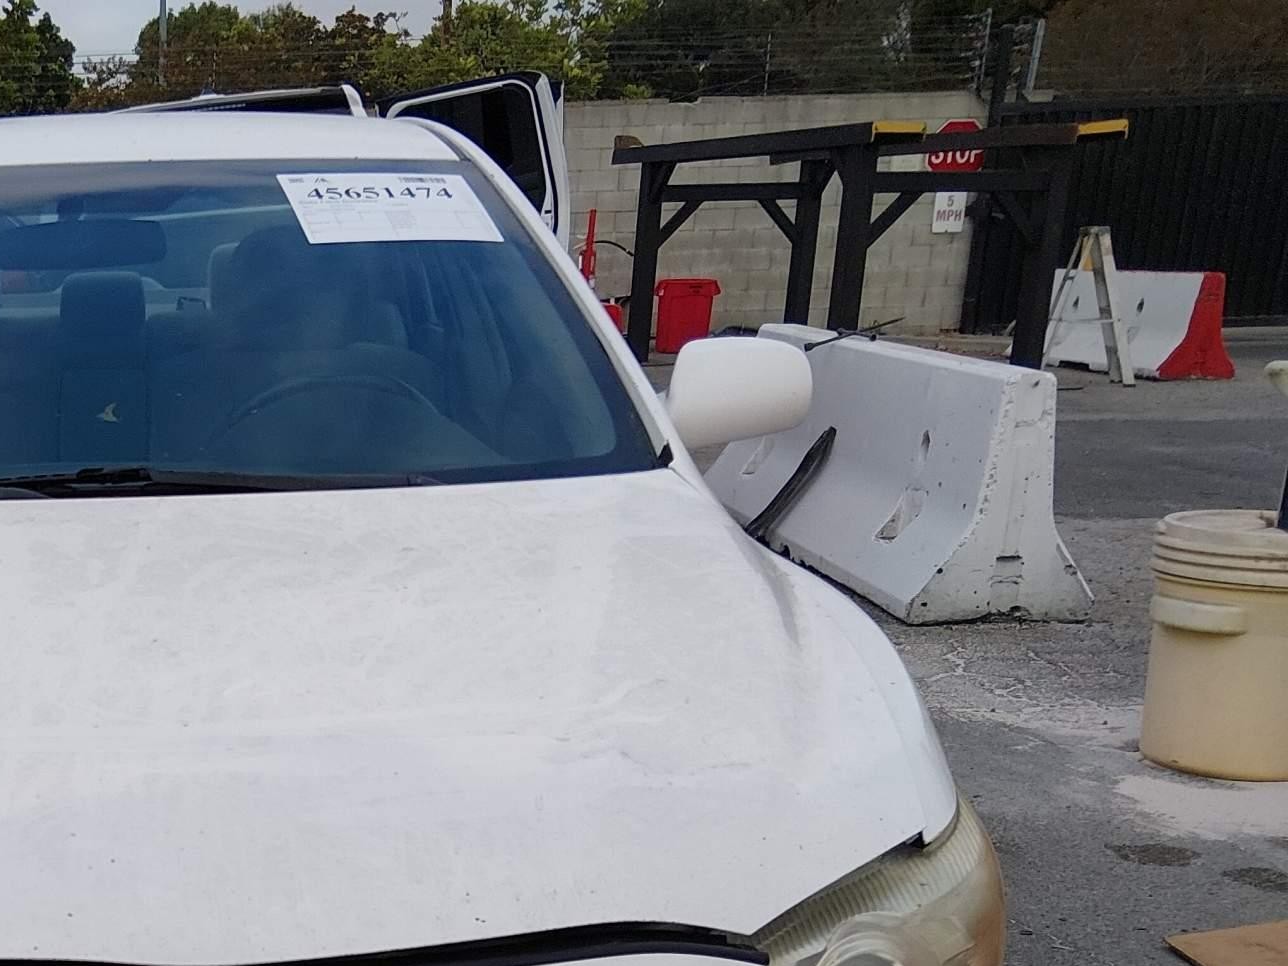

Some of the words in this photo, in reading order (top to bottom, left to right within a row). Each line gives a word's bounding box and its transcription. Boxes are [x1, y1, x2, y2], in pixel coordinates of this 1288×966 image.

[307, 186, 453, 200] 45651474
[947, 195, 955, 207] 5
[935, 210, 962, 221] MPH
